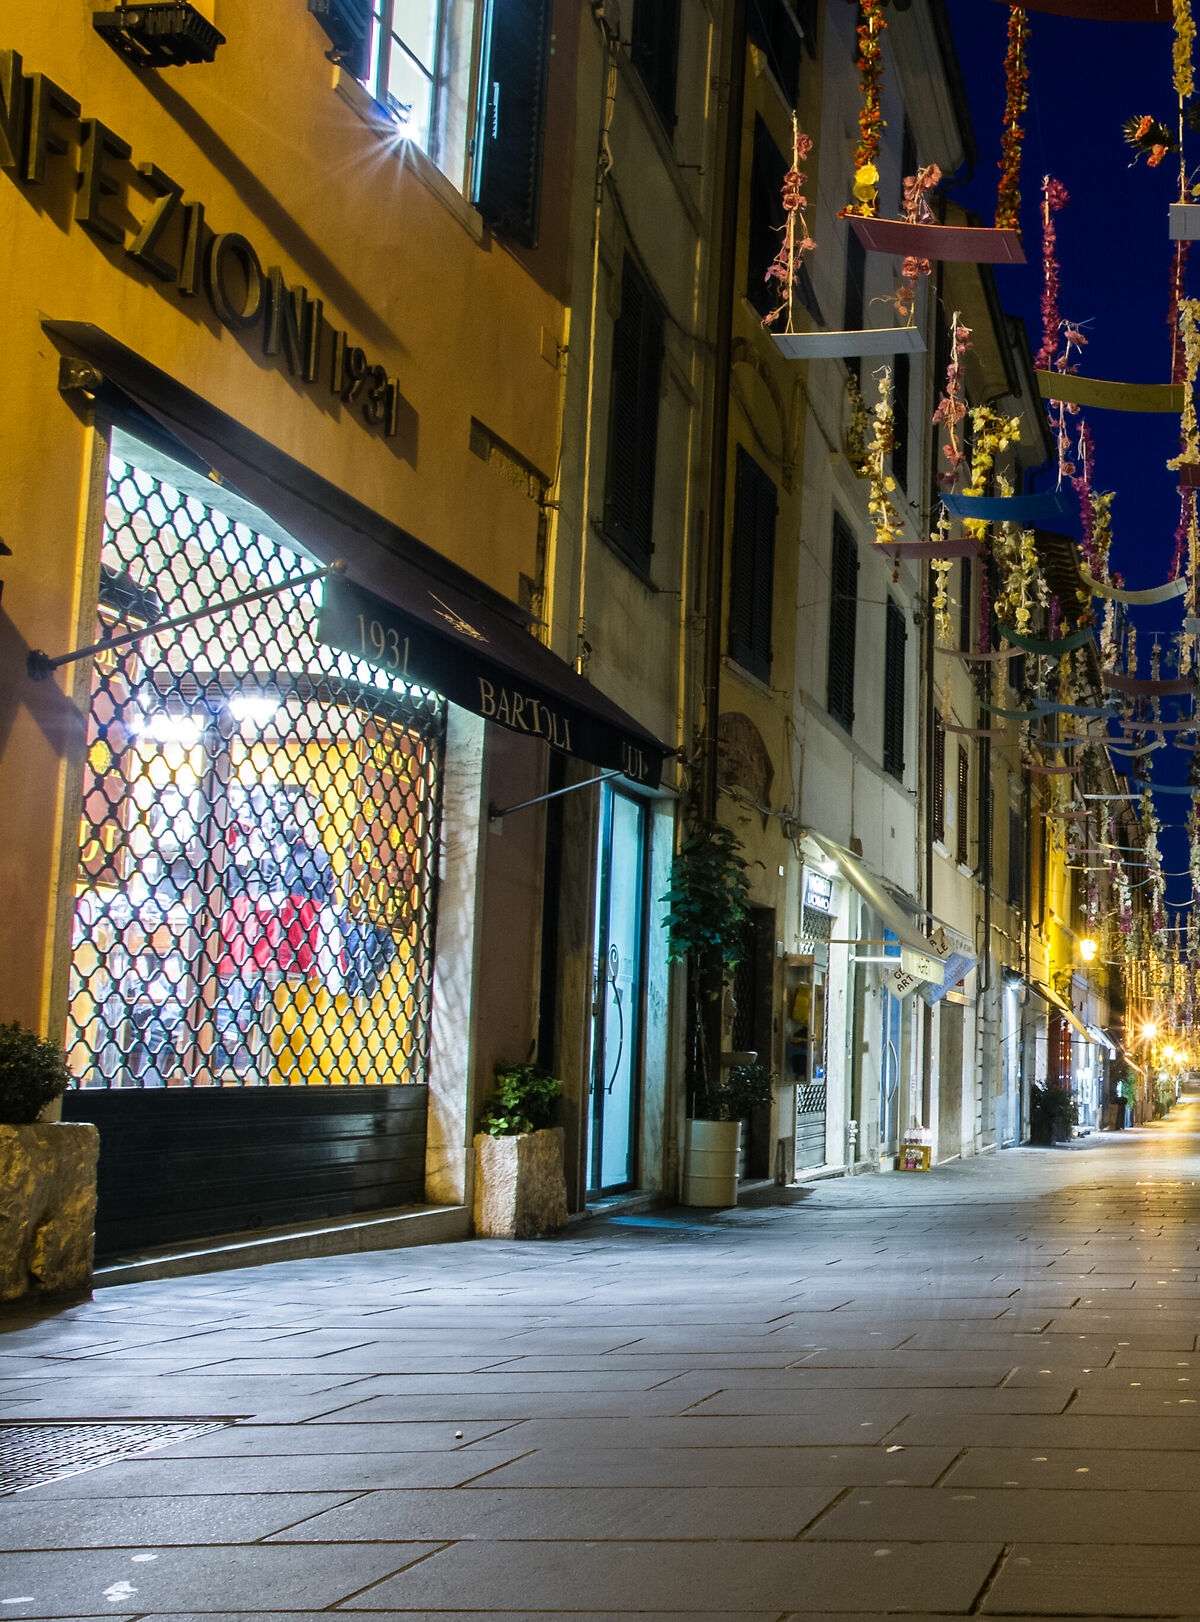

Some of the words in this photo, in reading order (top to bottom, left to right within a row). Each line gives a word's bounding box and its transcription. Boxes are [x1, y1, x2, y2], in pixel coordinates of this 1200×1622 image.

[331, 330, 400, 438] 1931
[357, 613, 411, 678] 1931
[478, 677, 573, 752] BARTOLI
[807, 891, 830, 911] UOMO
